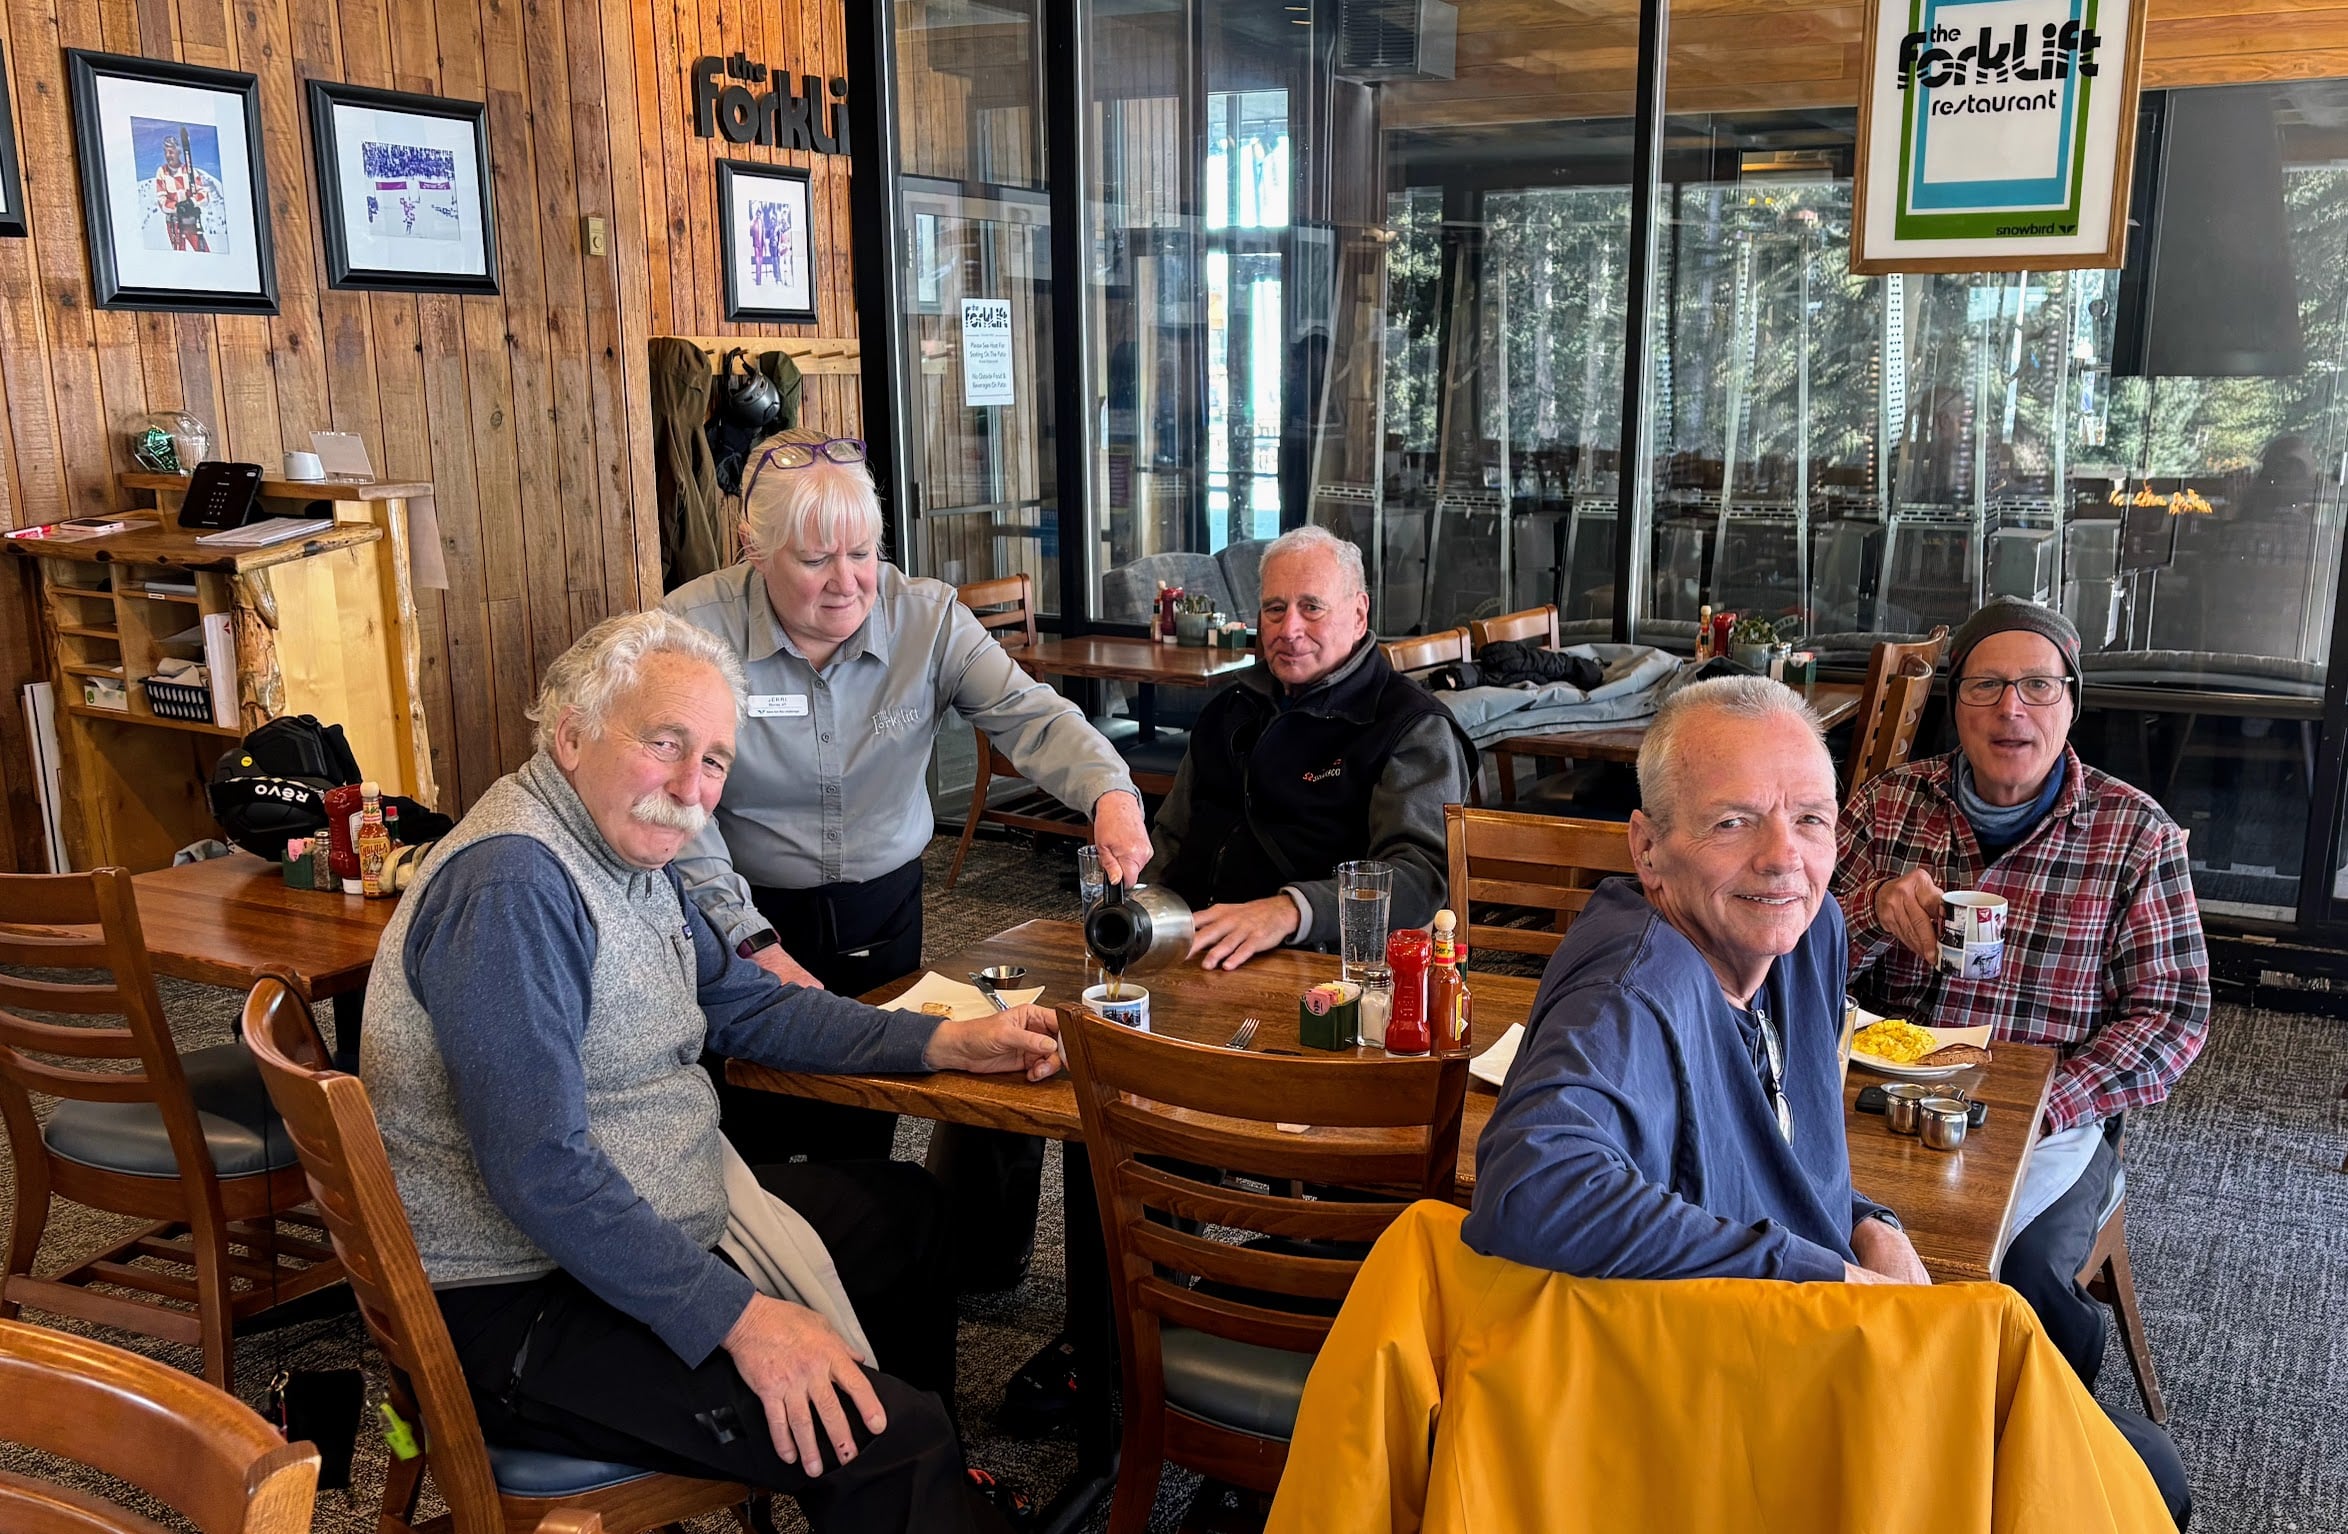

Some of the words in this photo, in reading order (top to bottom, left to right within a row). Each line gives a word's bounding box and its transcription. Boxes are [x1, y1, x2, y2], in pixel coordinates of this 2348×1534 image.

[1930, 23, 1962, 43] the
[727, 52, 767, 83] the
[691, 55, 851, 156] ForkLi
[1931, 89, 2057, 116] restaurant
[1995, 222, 2056, 236] snowbird
